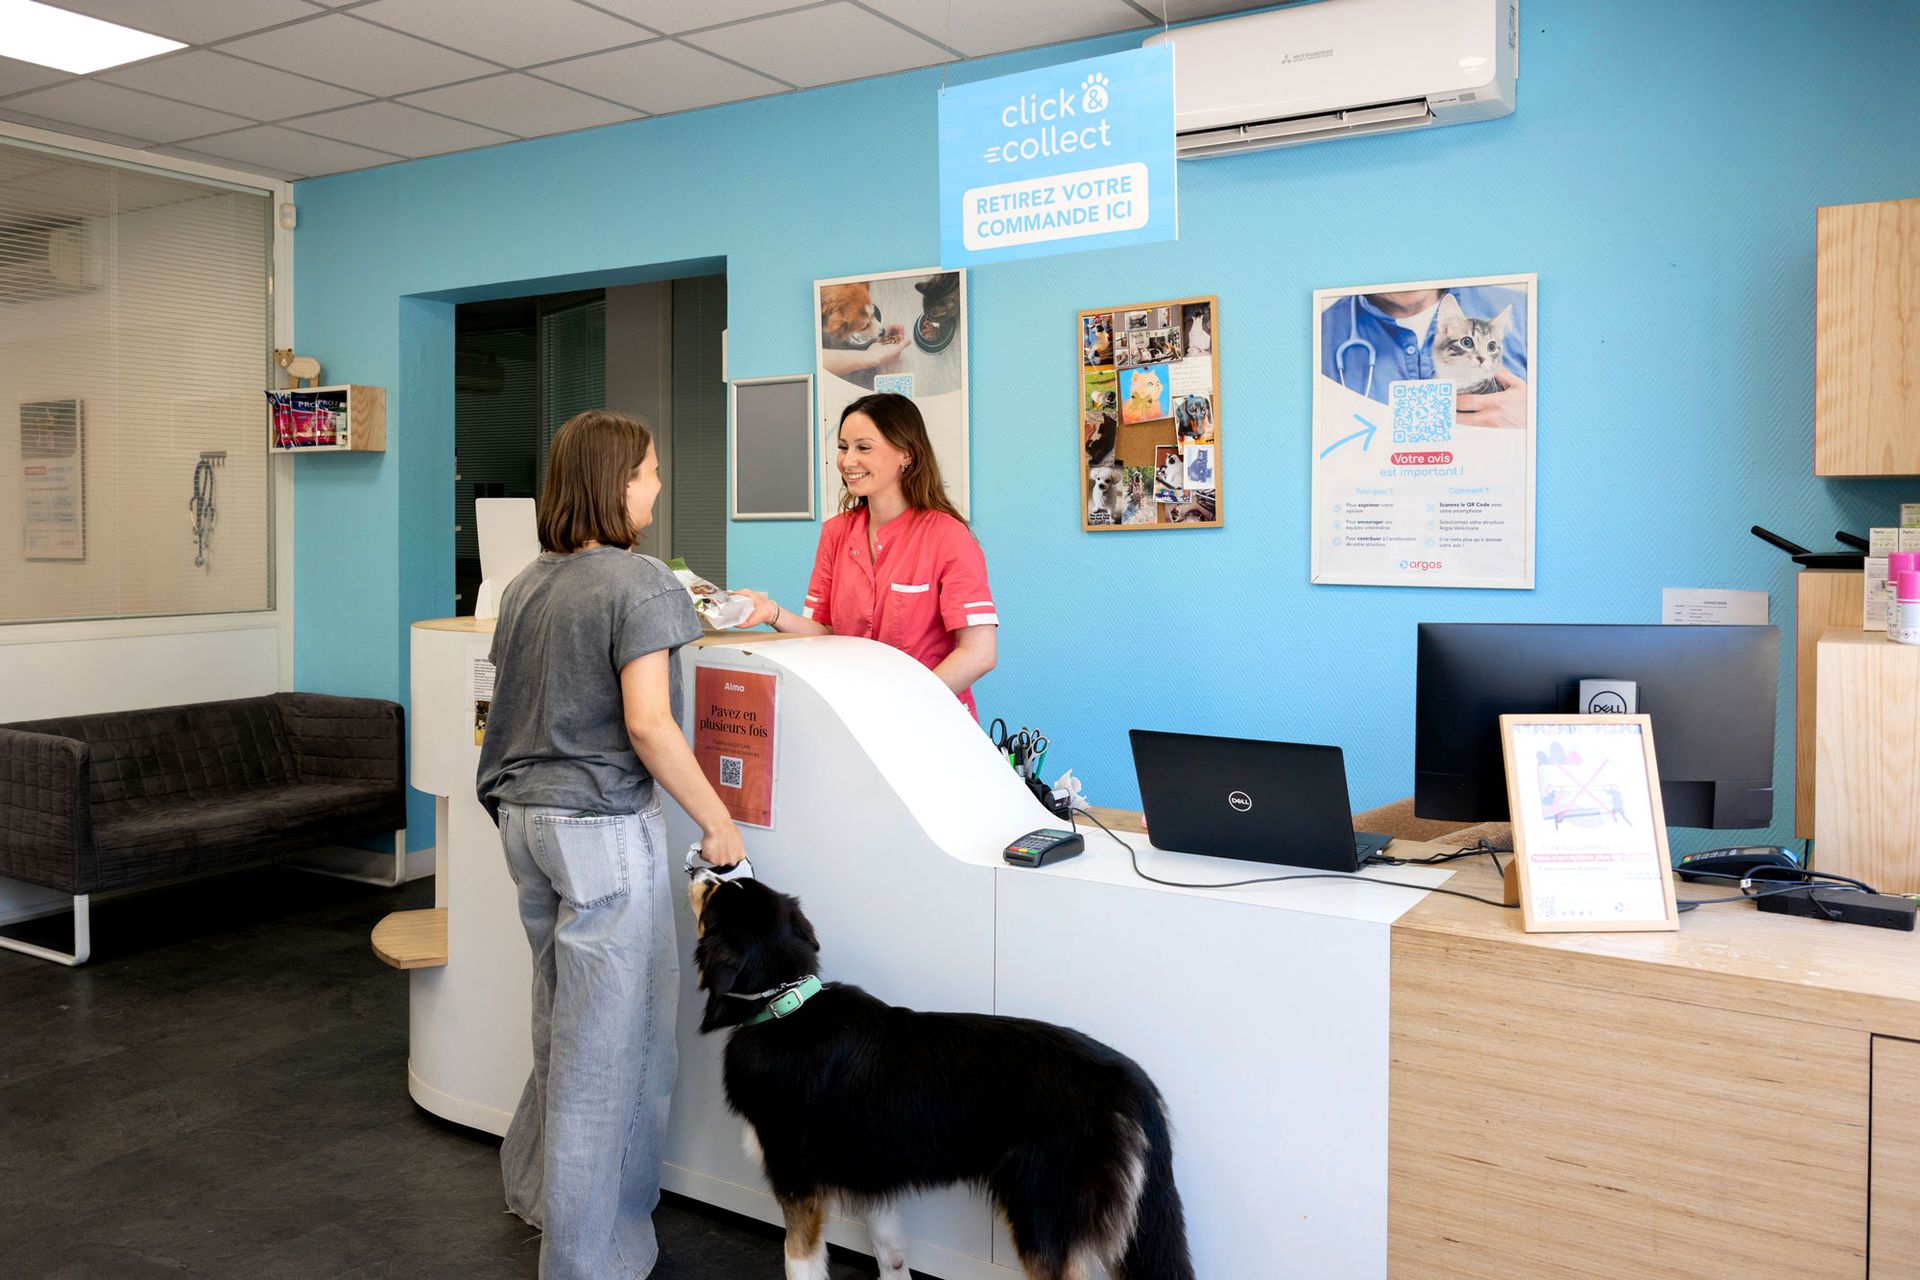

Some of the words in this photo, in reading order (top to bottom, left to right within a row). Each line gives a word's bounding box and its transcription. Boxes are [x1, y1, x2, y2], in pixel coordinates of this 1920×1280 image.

[1002, 88, 1076, 128] click
[1002, 118, 1111, 163] collect
[977, 186, 1055, 215] RETIREZ
[1062, 175, 1133, 202] VOTRE
[977, 205, 1099, 238] COMMANDE
[1107, 201, 1131, 221] ICI
[1393, 453, 1425, 464] Votre
[1427, 452, 1450, 463] avis
[1380, 468, 1397, 477] est
[1400, 467, 1458, 479] important
[1356, 488, 1388, 496] Pourquoi
[1409, 561, 1442, 571] argos
[724, 682, 745, 693] Alma
[1593, 704, 1623, 714] DELL
[743, 711, 757, 722] en
[700, 718, 747, 735] plusieurs
[749, 724, 768, 738] fois
